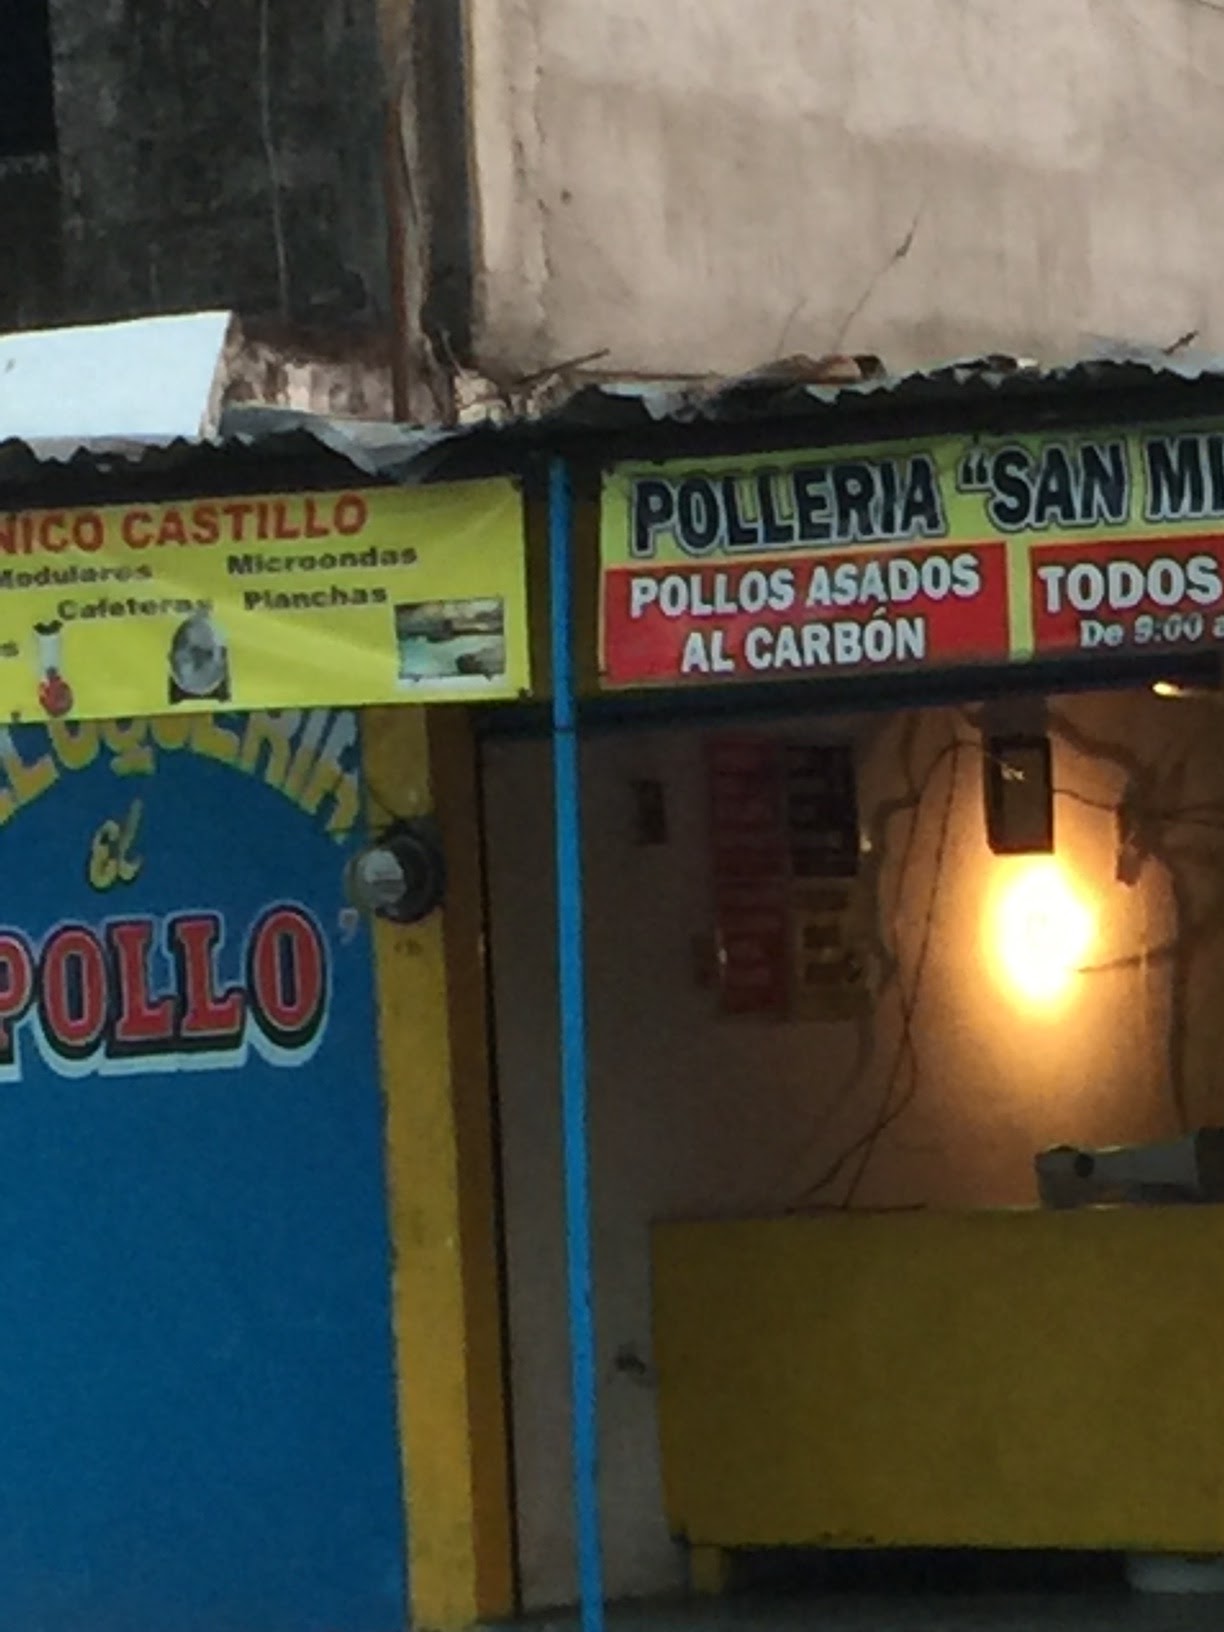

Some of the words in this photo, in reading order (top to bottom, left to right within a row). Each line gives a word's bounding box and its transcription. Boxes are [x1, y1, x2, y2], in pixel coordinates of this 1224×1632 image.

[121, 493, 367, 550] CASTILLO
[632, 454, 945, 556] POLLERIA
[227, 546, 418, 575] Microondas
[630, 568, 795, 618] POLLOS
[806, 553, 981, 607] ASADOS
[1039, 555, 1223, 613] TODOS
[244, 585, 388, 610] Planchas
[681, 630, 735, 674] AL
[745, 606, 925, 671] CARBÓN
[1079, 618, 1124, 648] De
